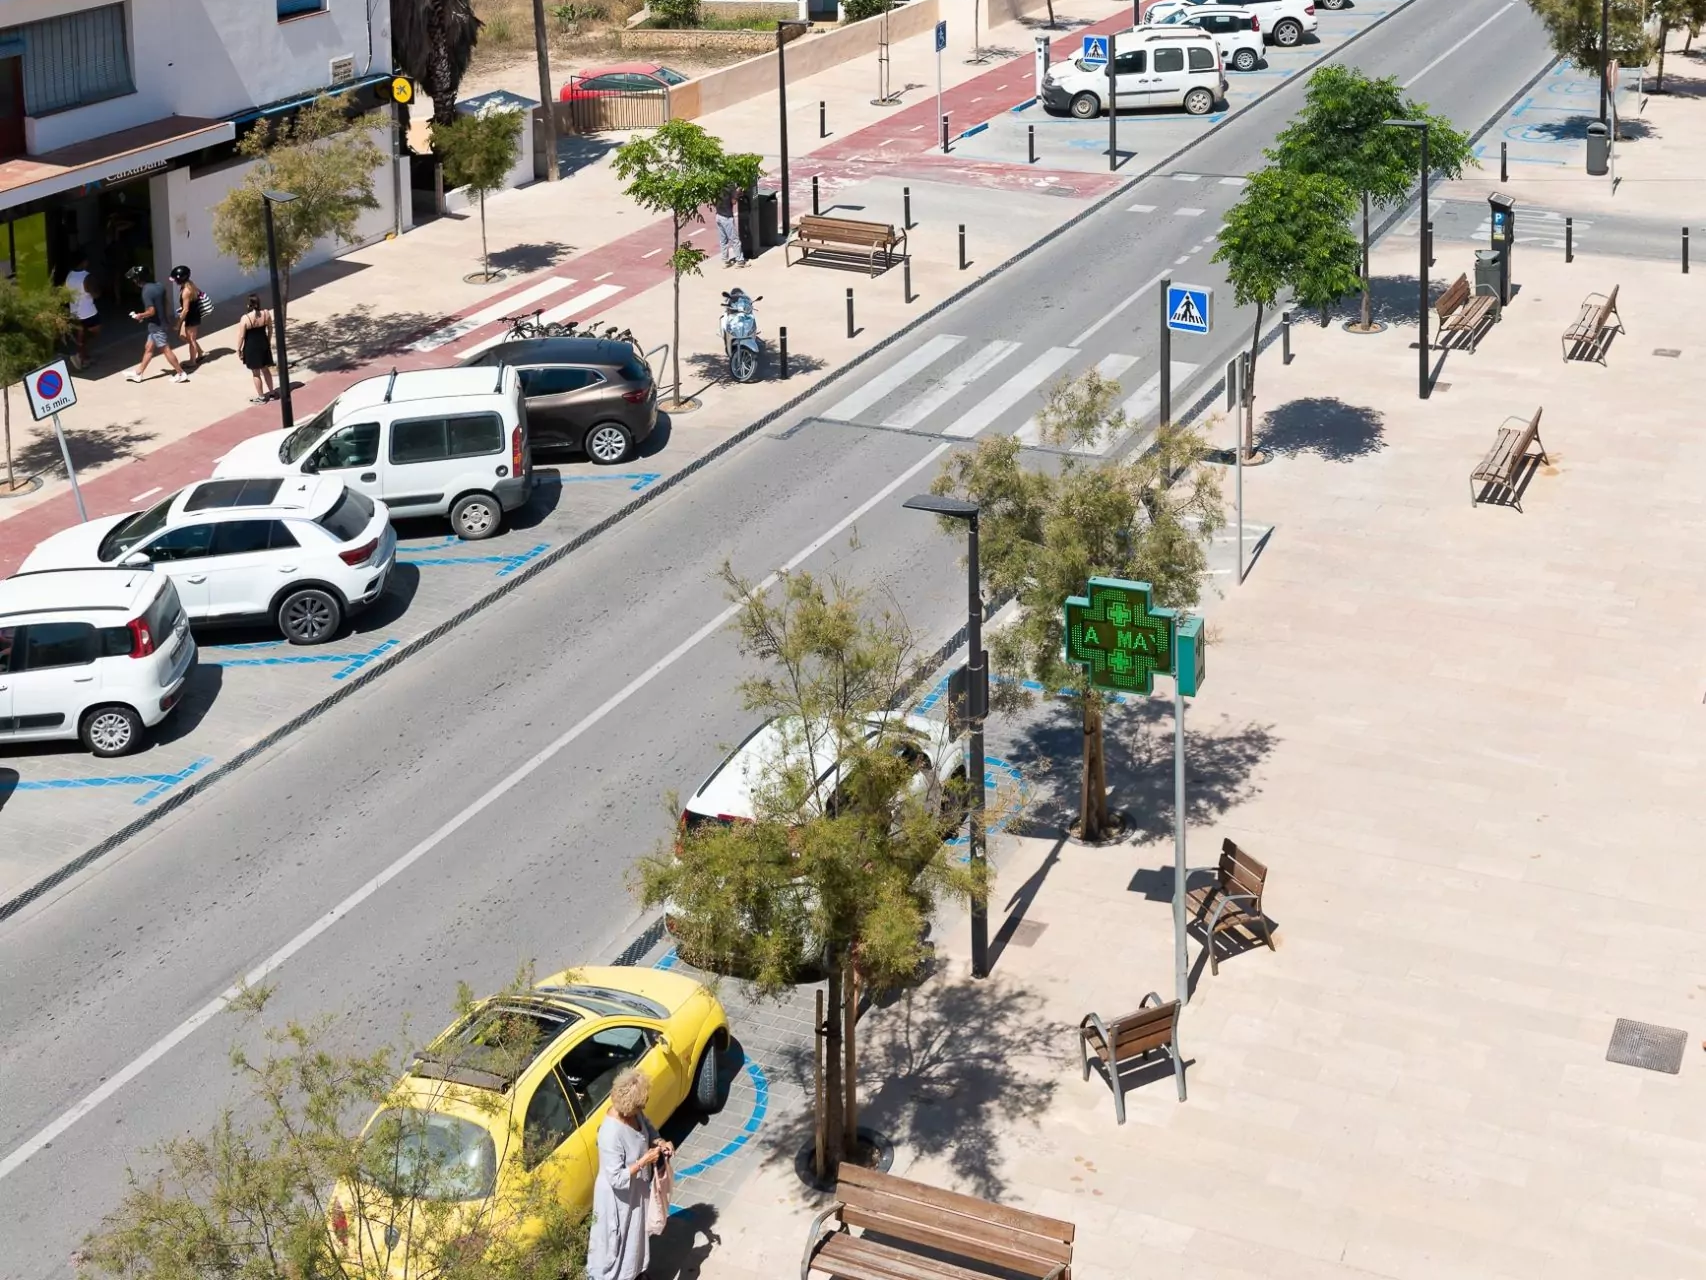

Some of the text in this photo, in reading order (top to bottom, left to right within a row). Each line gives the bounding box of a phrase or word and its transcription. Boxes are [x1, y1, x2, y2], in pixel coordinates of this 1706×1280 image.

[1495, 212, 1502, 223] P
[41, 404, 51, 414] 15
[1084, 626, 1100, 645] A
